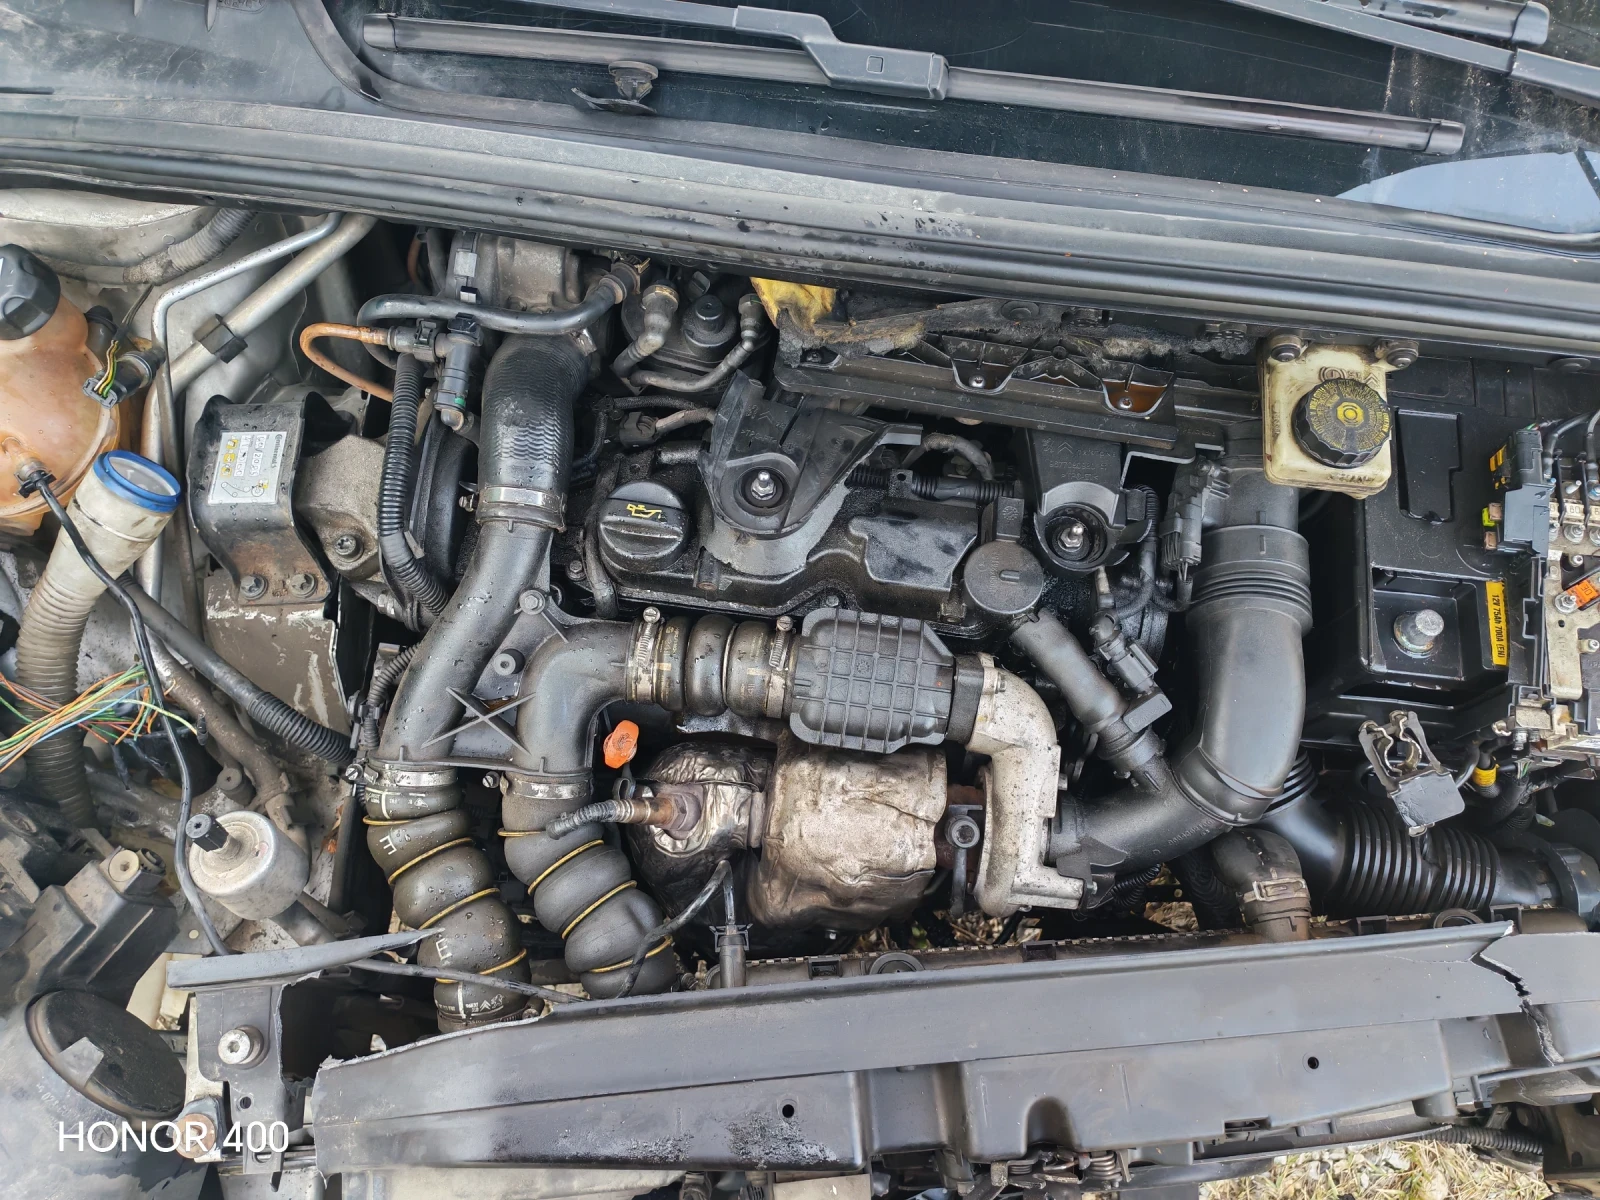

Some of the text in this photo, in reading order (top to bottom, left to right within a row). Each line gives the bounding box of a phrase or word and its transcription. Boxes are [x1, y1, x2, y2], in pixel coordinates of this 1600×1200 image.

[1491, 594, 1505, 658] 12V 75Ah 700A (EN)
